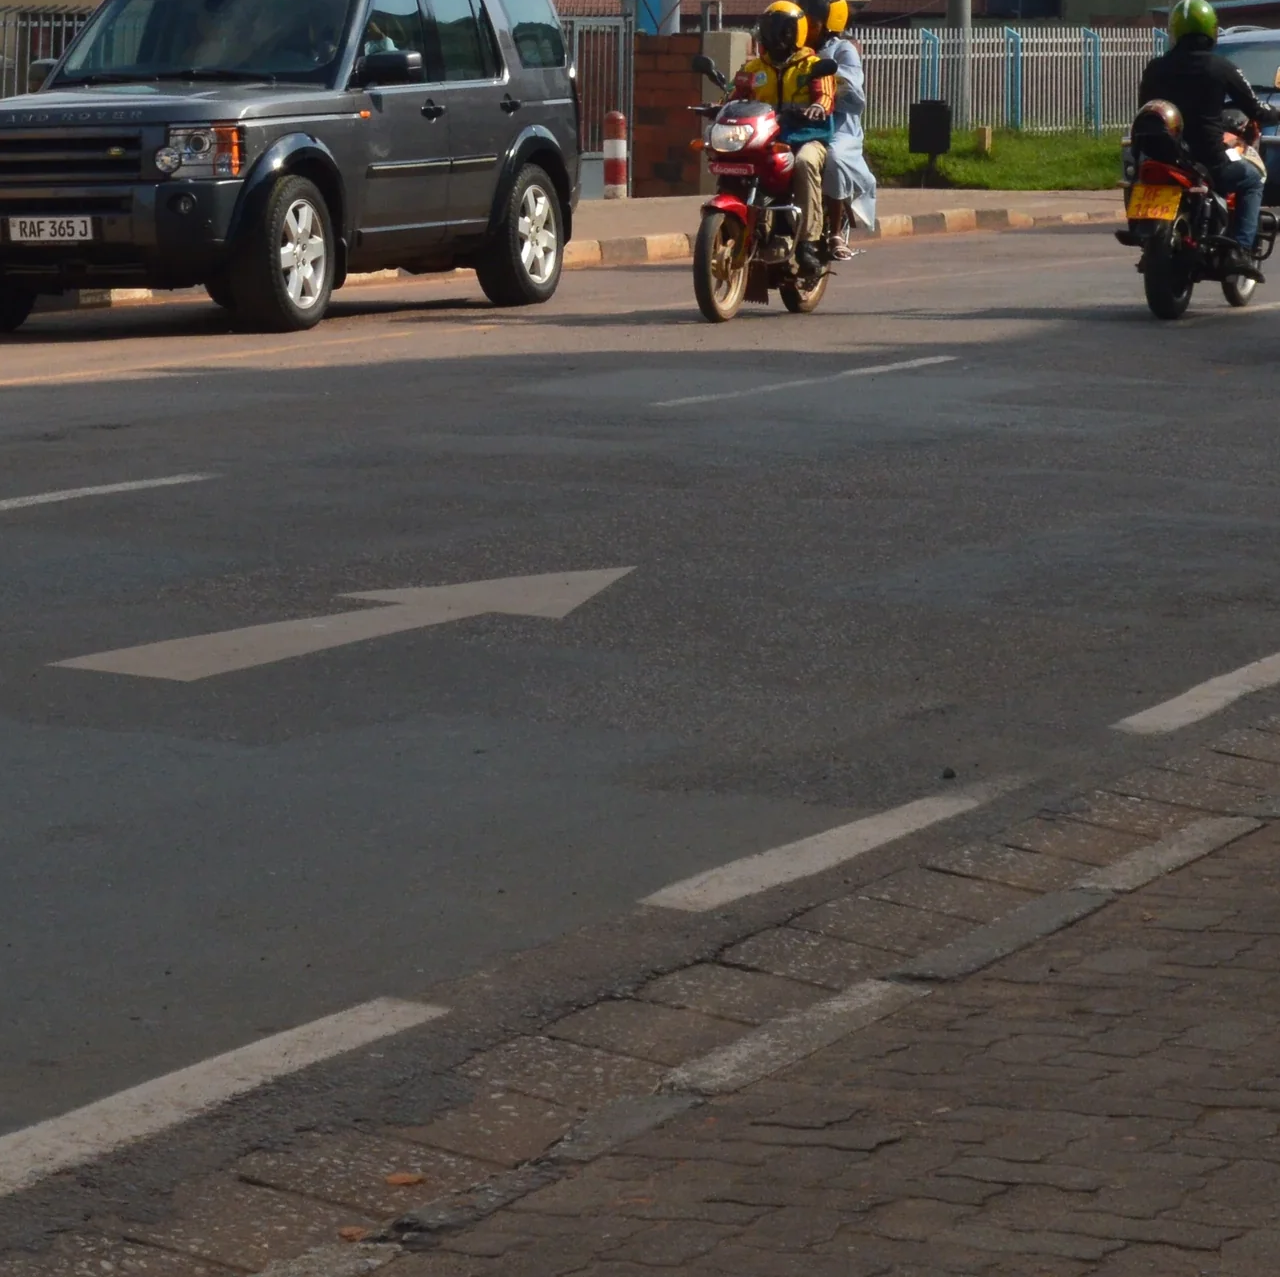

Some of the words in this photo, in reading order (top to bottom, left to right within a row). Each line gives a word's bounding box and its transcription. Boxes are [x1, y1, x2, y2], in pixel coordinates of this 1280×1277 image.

[61, 110, 144, 121] ROVER
[19, 220, 45, 237] RAF
[48, 220, 75, 237] 365
[79, 220, 88, 237] J
